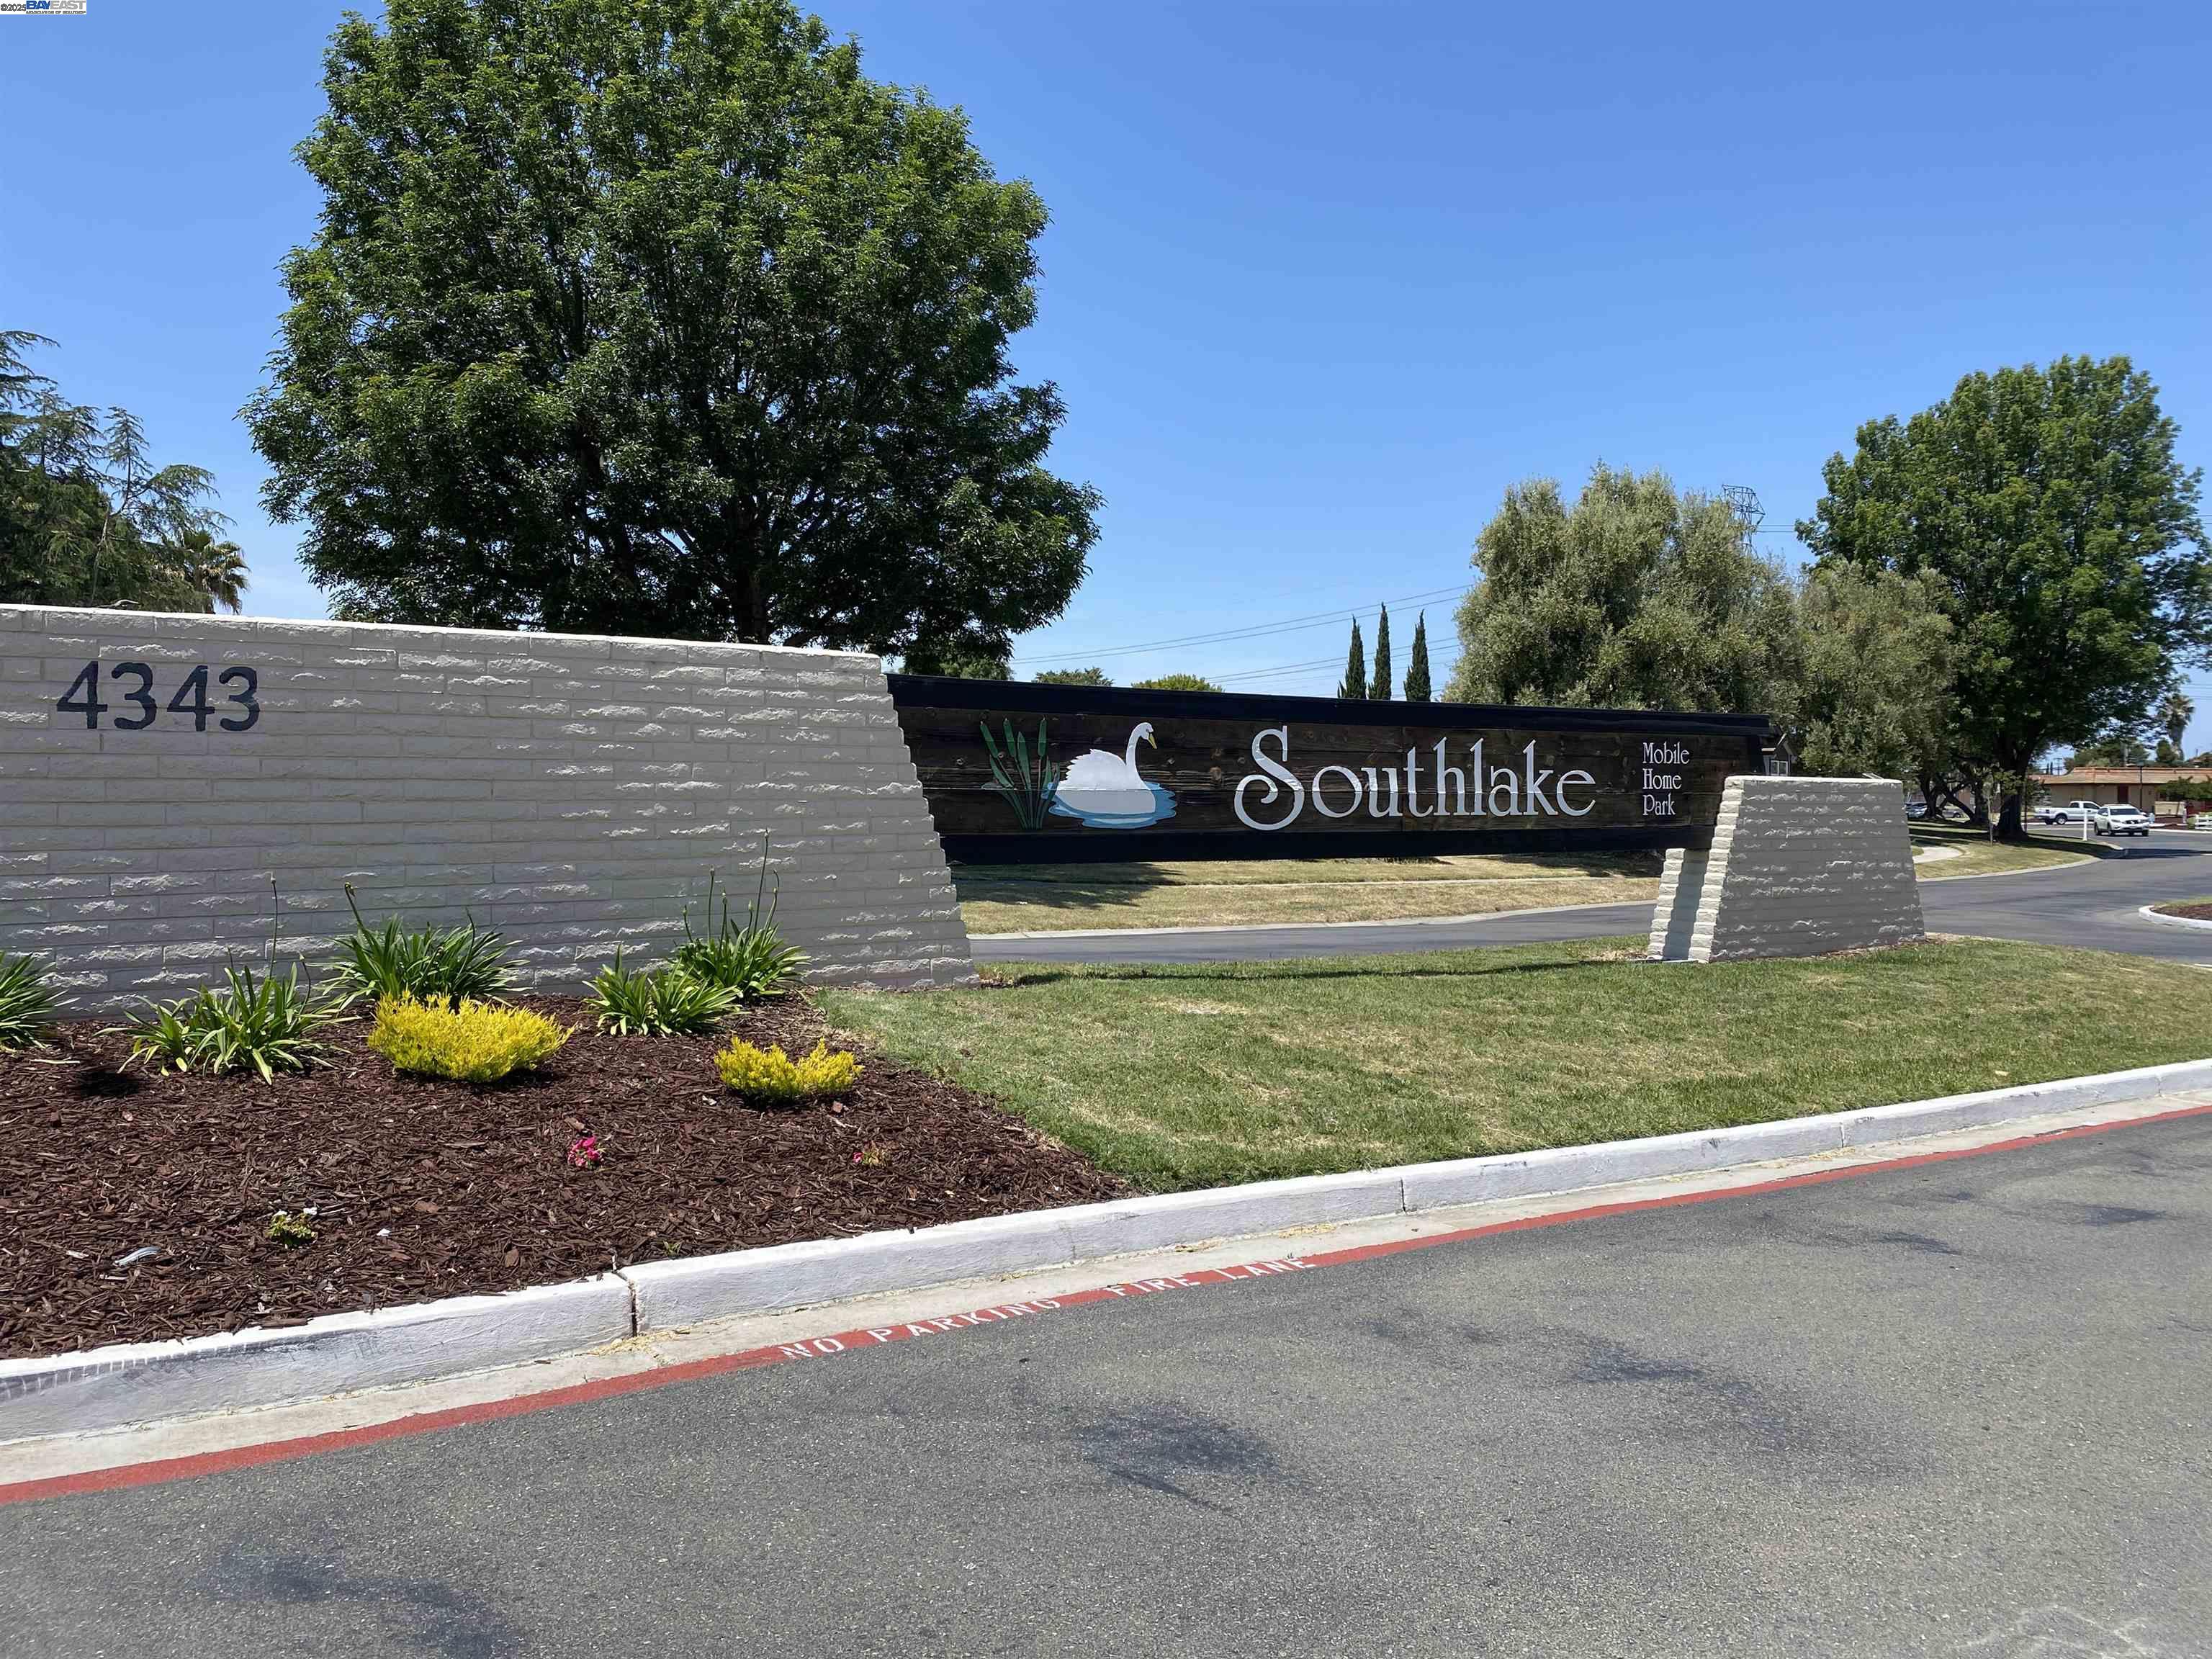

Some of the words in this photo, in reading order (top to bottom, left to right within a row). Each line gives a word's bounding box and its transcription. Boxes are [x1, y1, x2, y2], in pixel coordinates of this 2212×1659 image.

[56, 660, 261, 732] 4343
[1642, 741, 1690, 765] Mobile
[1233, 725, 1596, 831] Southlake
[1642, 768, 1682, 790] Home
[1642, 793, 1676, 816] Park
[779, 1337, 845, 1359] NO
[867, 1298, 1061, 1342] PARKING
[1103, 1274, 1201, 1297] FIRE
[1215, 1256, 1316, 1280] LANE
